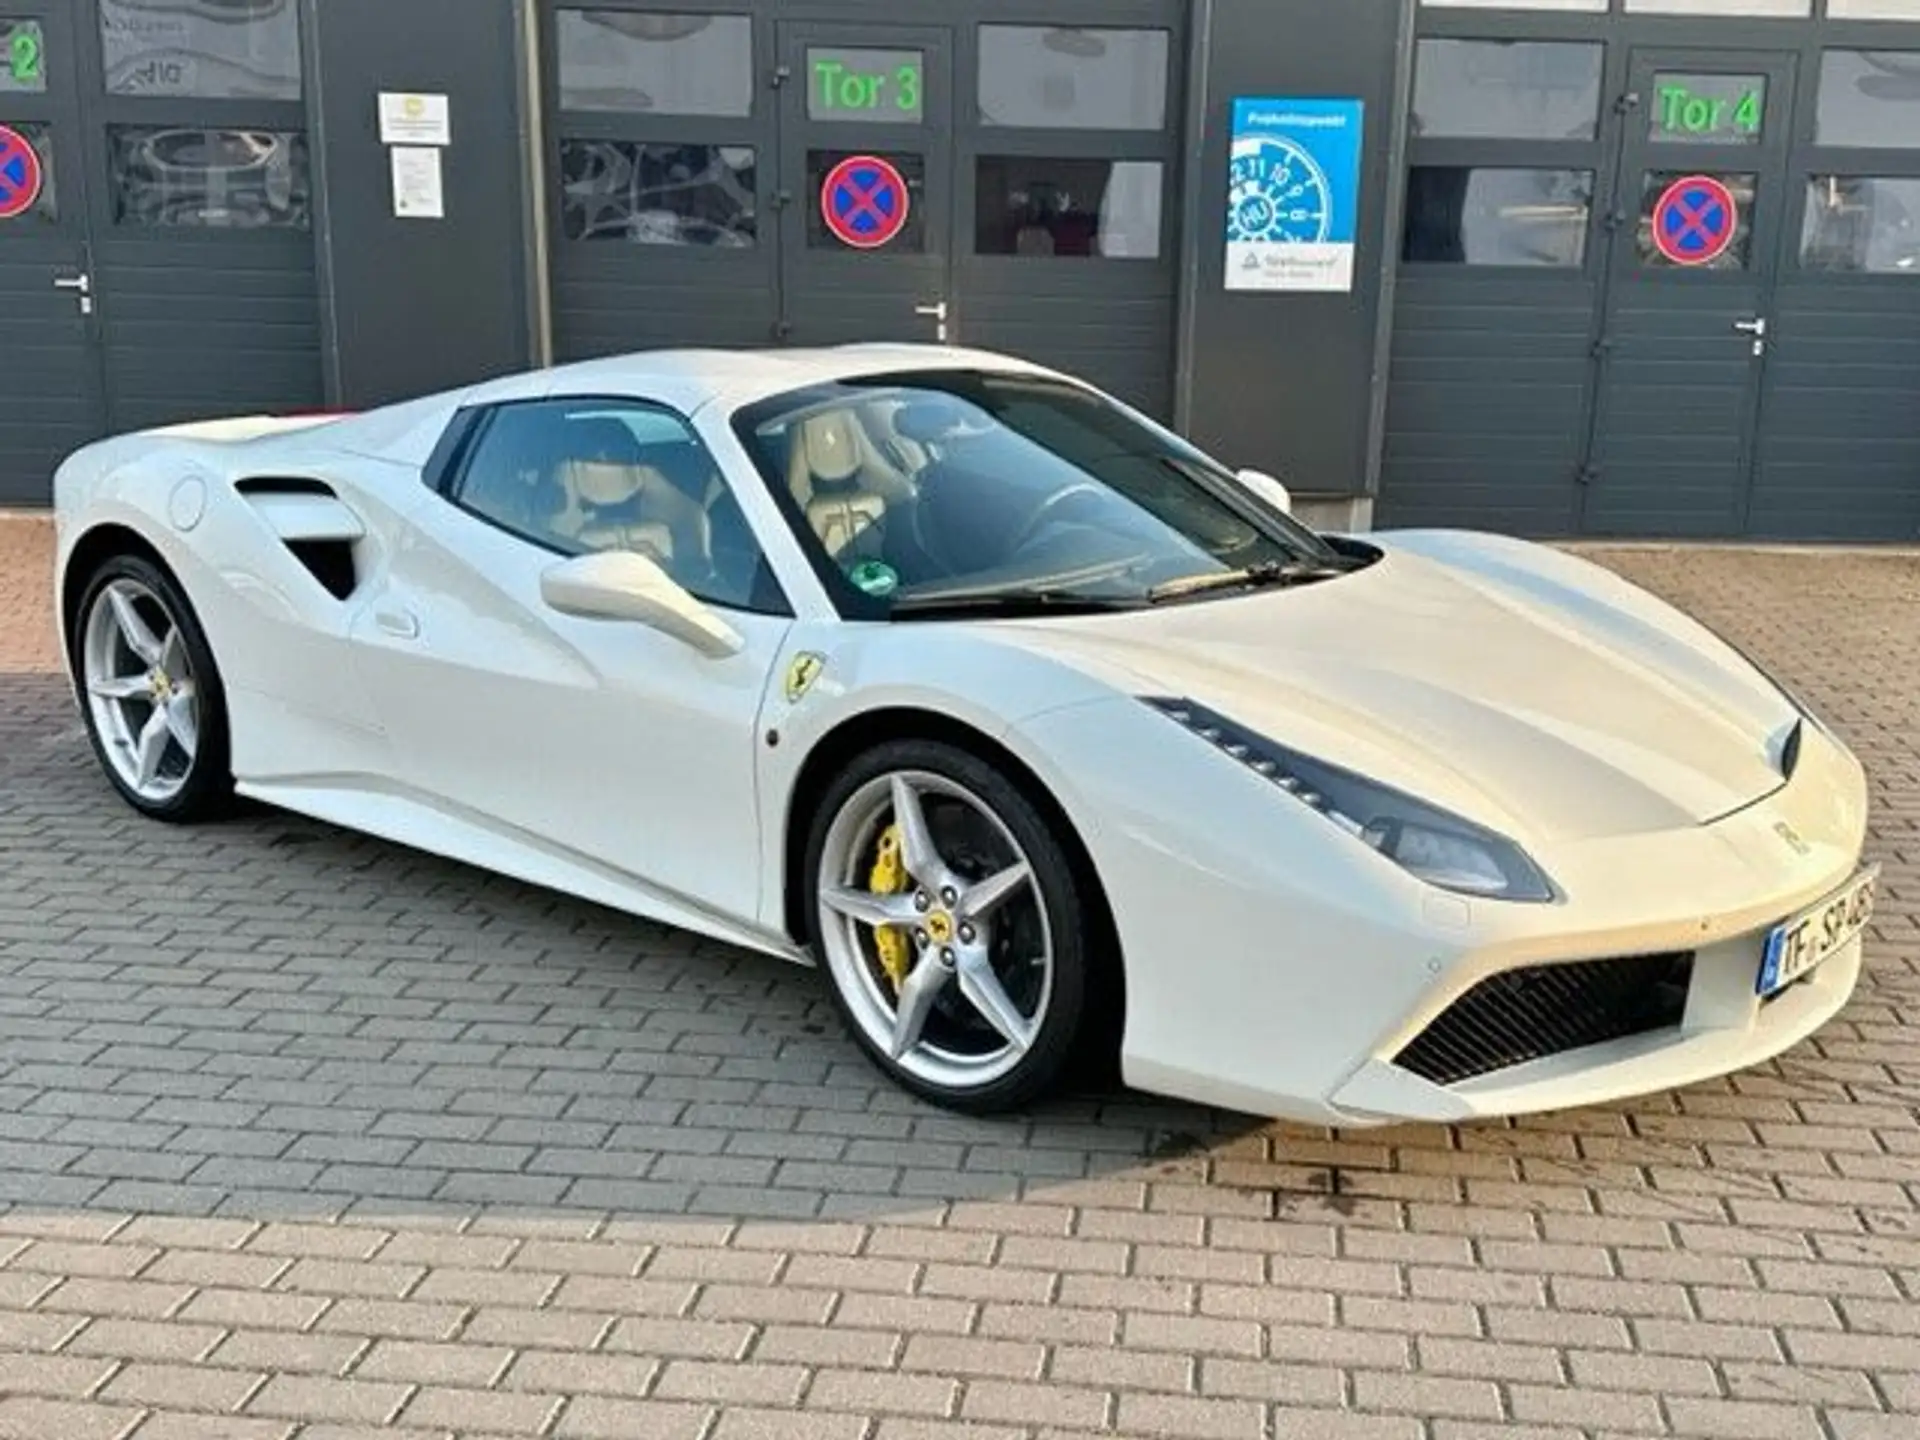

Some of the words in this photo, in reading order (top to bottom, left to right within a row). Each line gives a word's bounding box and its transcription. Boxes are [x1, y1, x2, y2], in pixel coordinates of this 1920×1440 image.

[13, 35, 38, 78] 2
[814, 61, 885, 109] Tor
[896, 66, 917, 110] 3
[1660, 86, 1727, 132] Tor
[1733, 89, 1759, 132] 4
[1785, 919, 1810, 975] TF
